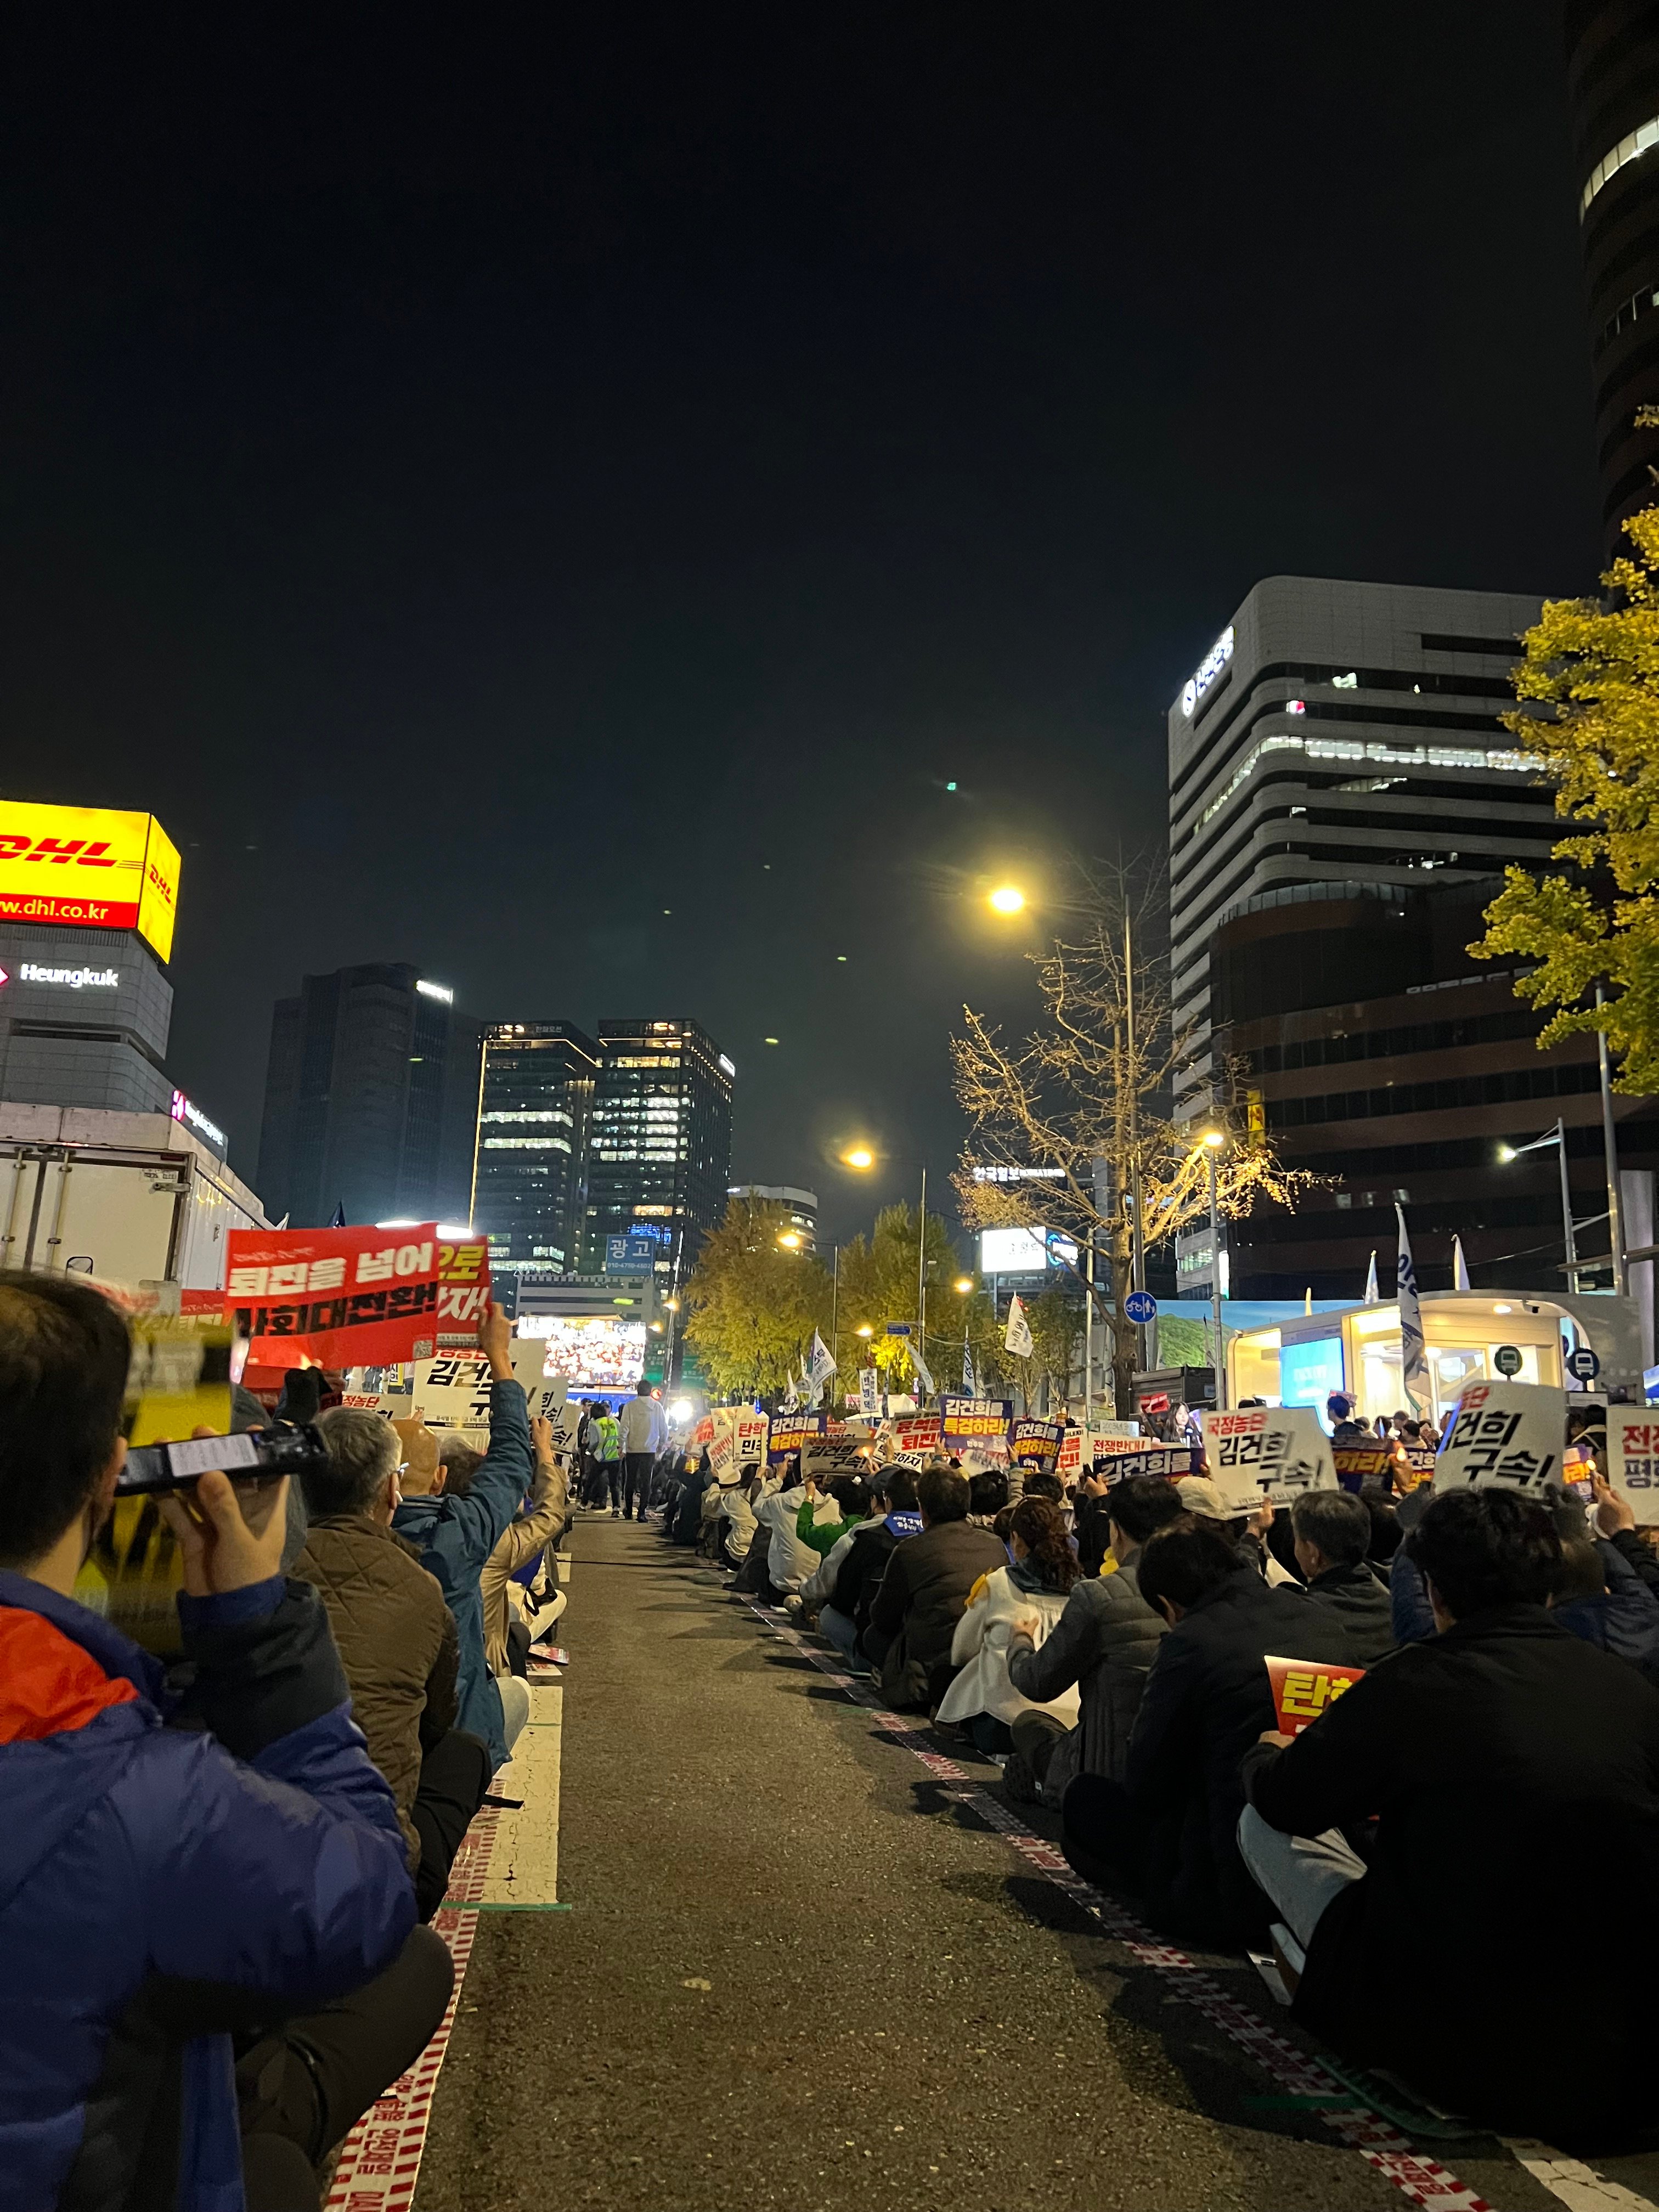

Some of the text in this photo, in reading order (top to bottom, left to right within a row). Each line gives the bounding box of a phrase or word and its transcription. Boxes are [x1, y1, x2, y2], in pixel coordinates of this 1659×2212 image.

[0, 834, 117, 867] DHL
[149, 864, 172, 905] DHL
[20, 963, 119, 988] Heungkuk
[610, 1239, 650, 1259] 광고
[227, 1242, 435, 1297] 퇴진을 넘어
[342, 1395, 380, 1409] 정농단
[945, 1398, 1003, 1417] 김건희를
[771, 1416, 820, 1435] 김건희를
[943, 1417, 1011, 1435] 특검하라!
[1015, 1423, 1059, 1441] 김건희를
[1207, 1412, 1267, 1436] 국정농단
[807, 1444, 857, 1459] 김건희
[1093, 1439, 1146, 1453] 전쟁반대!
[1219, 1430, 1293, 1466] 김건희
[830, 1455, 867, 1469] 구속!
[1463, 1449, 1555, 1486] 구속!
[1256, 1457, 1323, 1493] 구속!
